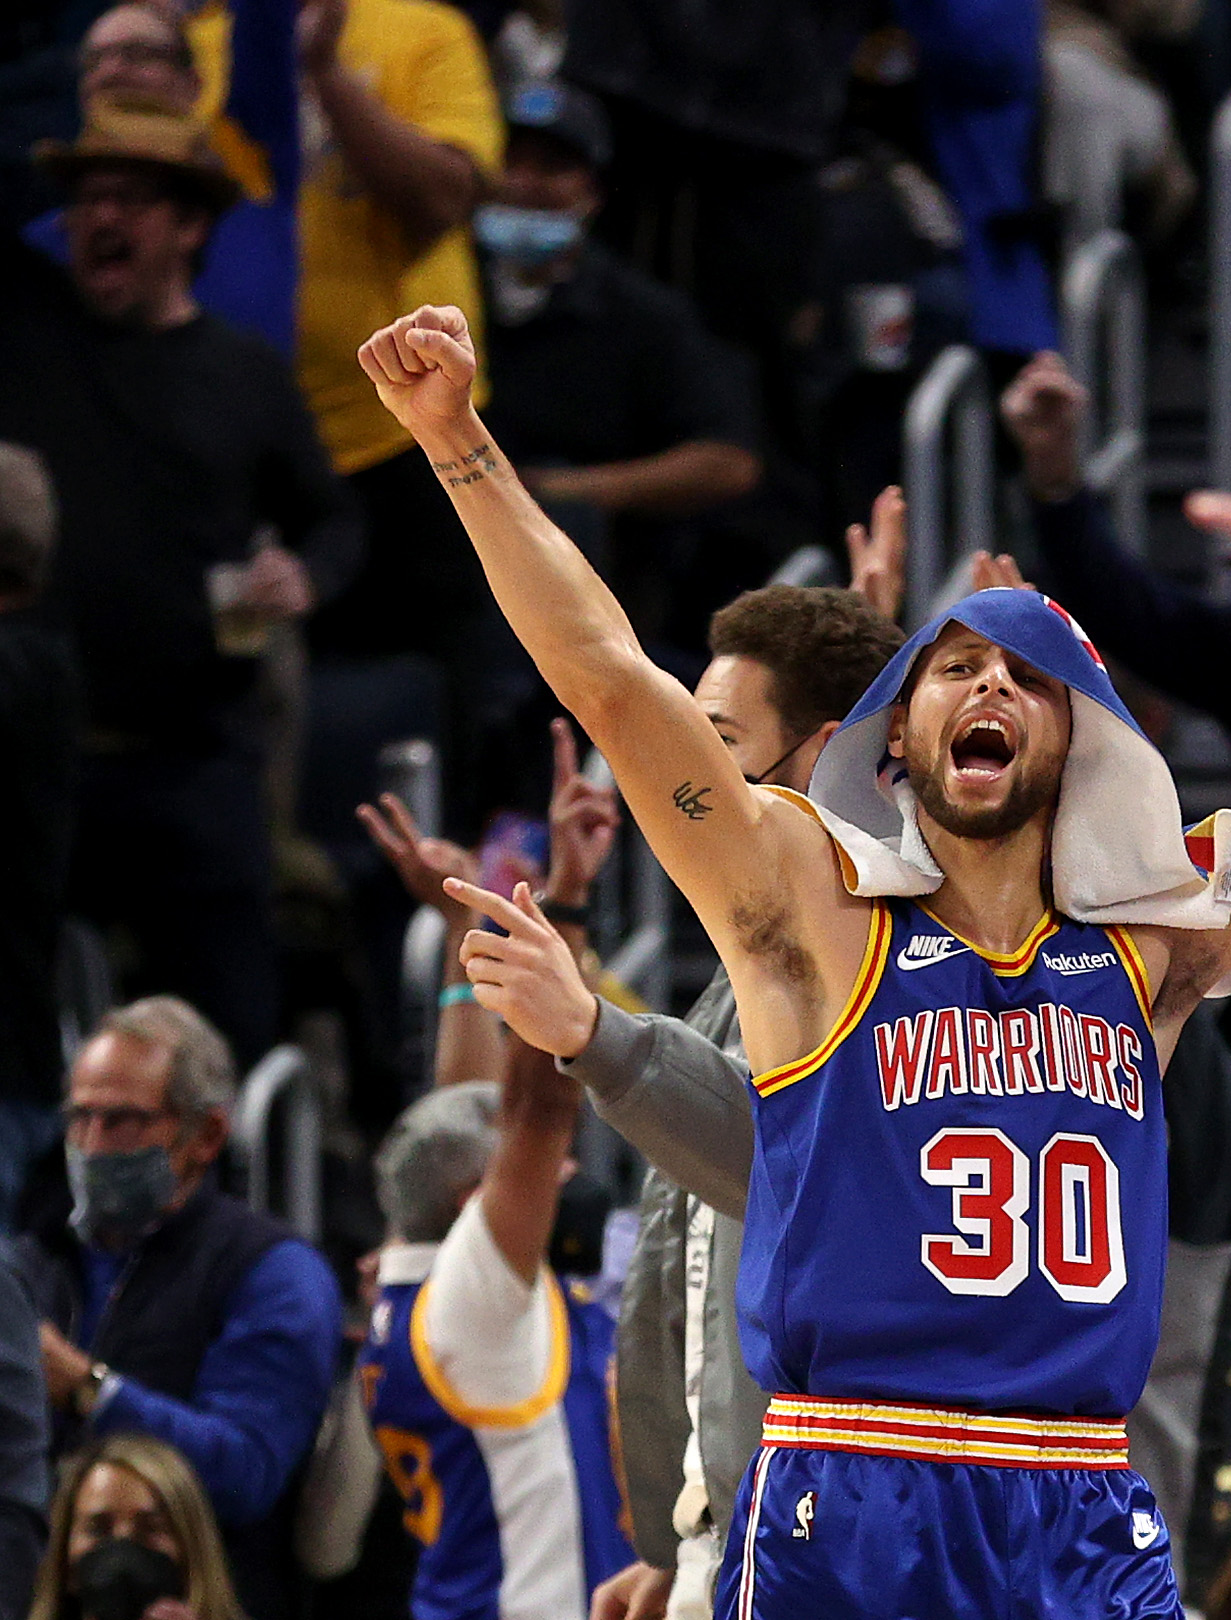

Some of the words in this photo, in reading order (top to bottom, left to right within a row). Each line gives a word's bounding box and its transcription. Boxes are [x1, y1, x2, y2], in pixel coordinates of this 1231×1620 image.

[906, 935, 955, 957] NIKE
[1041, 951, 1117, 972] Rakuten
[873, 1002, 1145, 1121] WARRIORS
[920, 1127, 1128, 1304] 30
